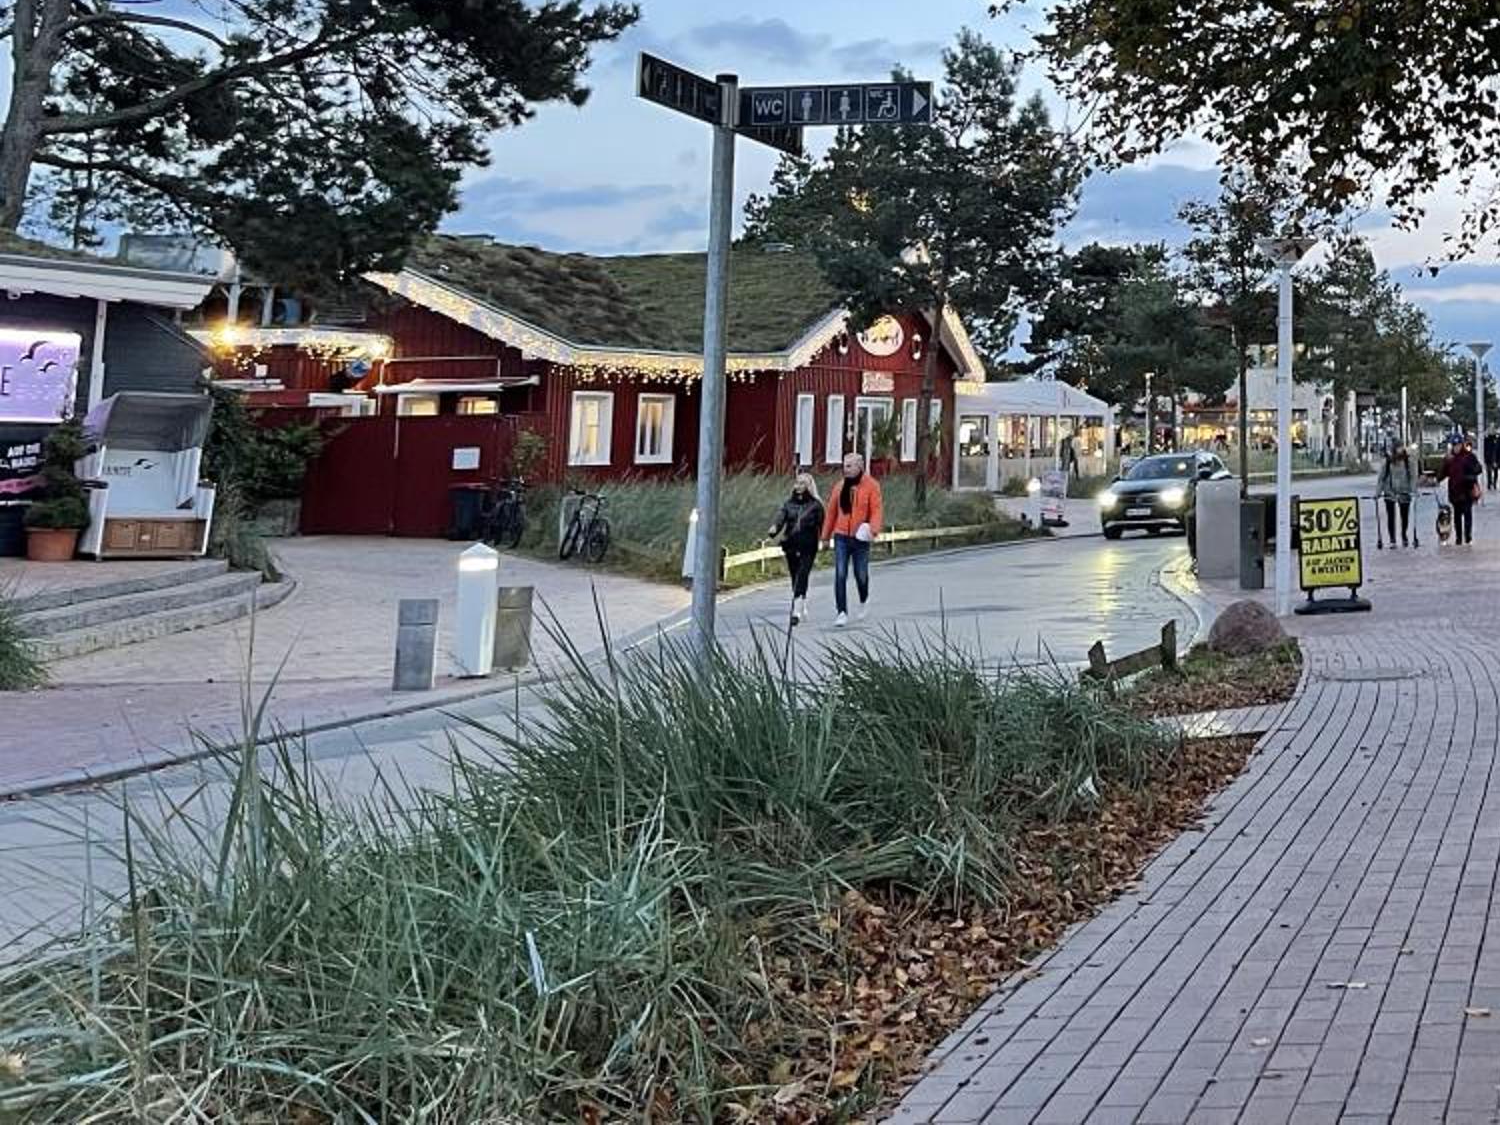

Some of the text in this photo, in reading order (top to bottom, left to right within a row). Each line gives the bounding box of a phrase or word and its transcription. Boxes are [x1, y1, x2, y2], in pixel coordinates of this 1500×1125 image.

[755, 99, 783, 116] WC
[1300, 506, 1358, 533] 30%
[1302, 535, 1357, 554] RABATT
